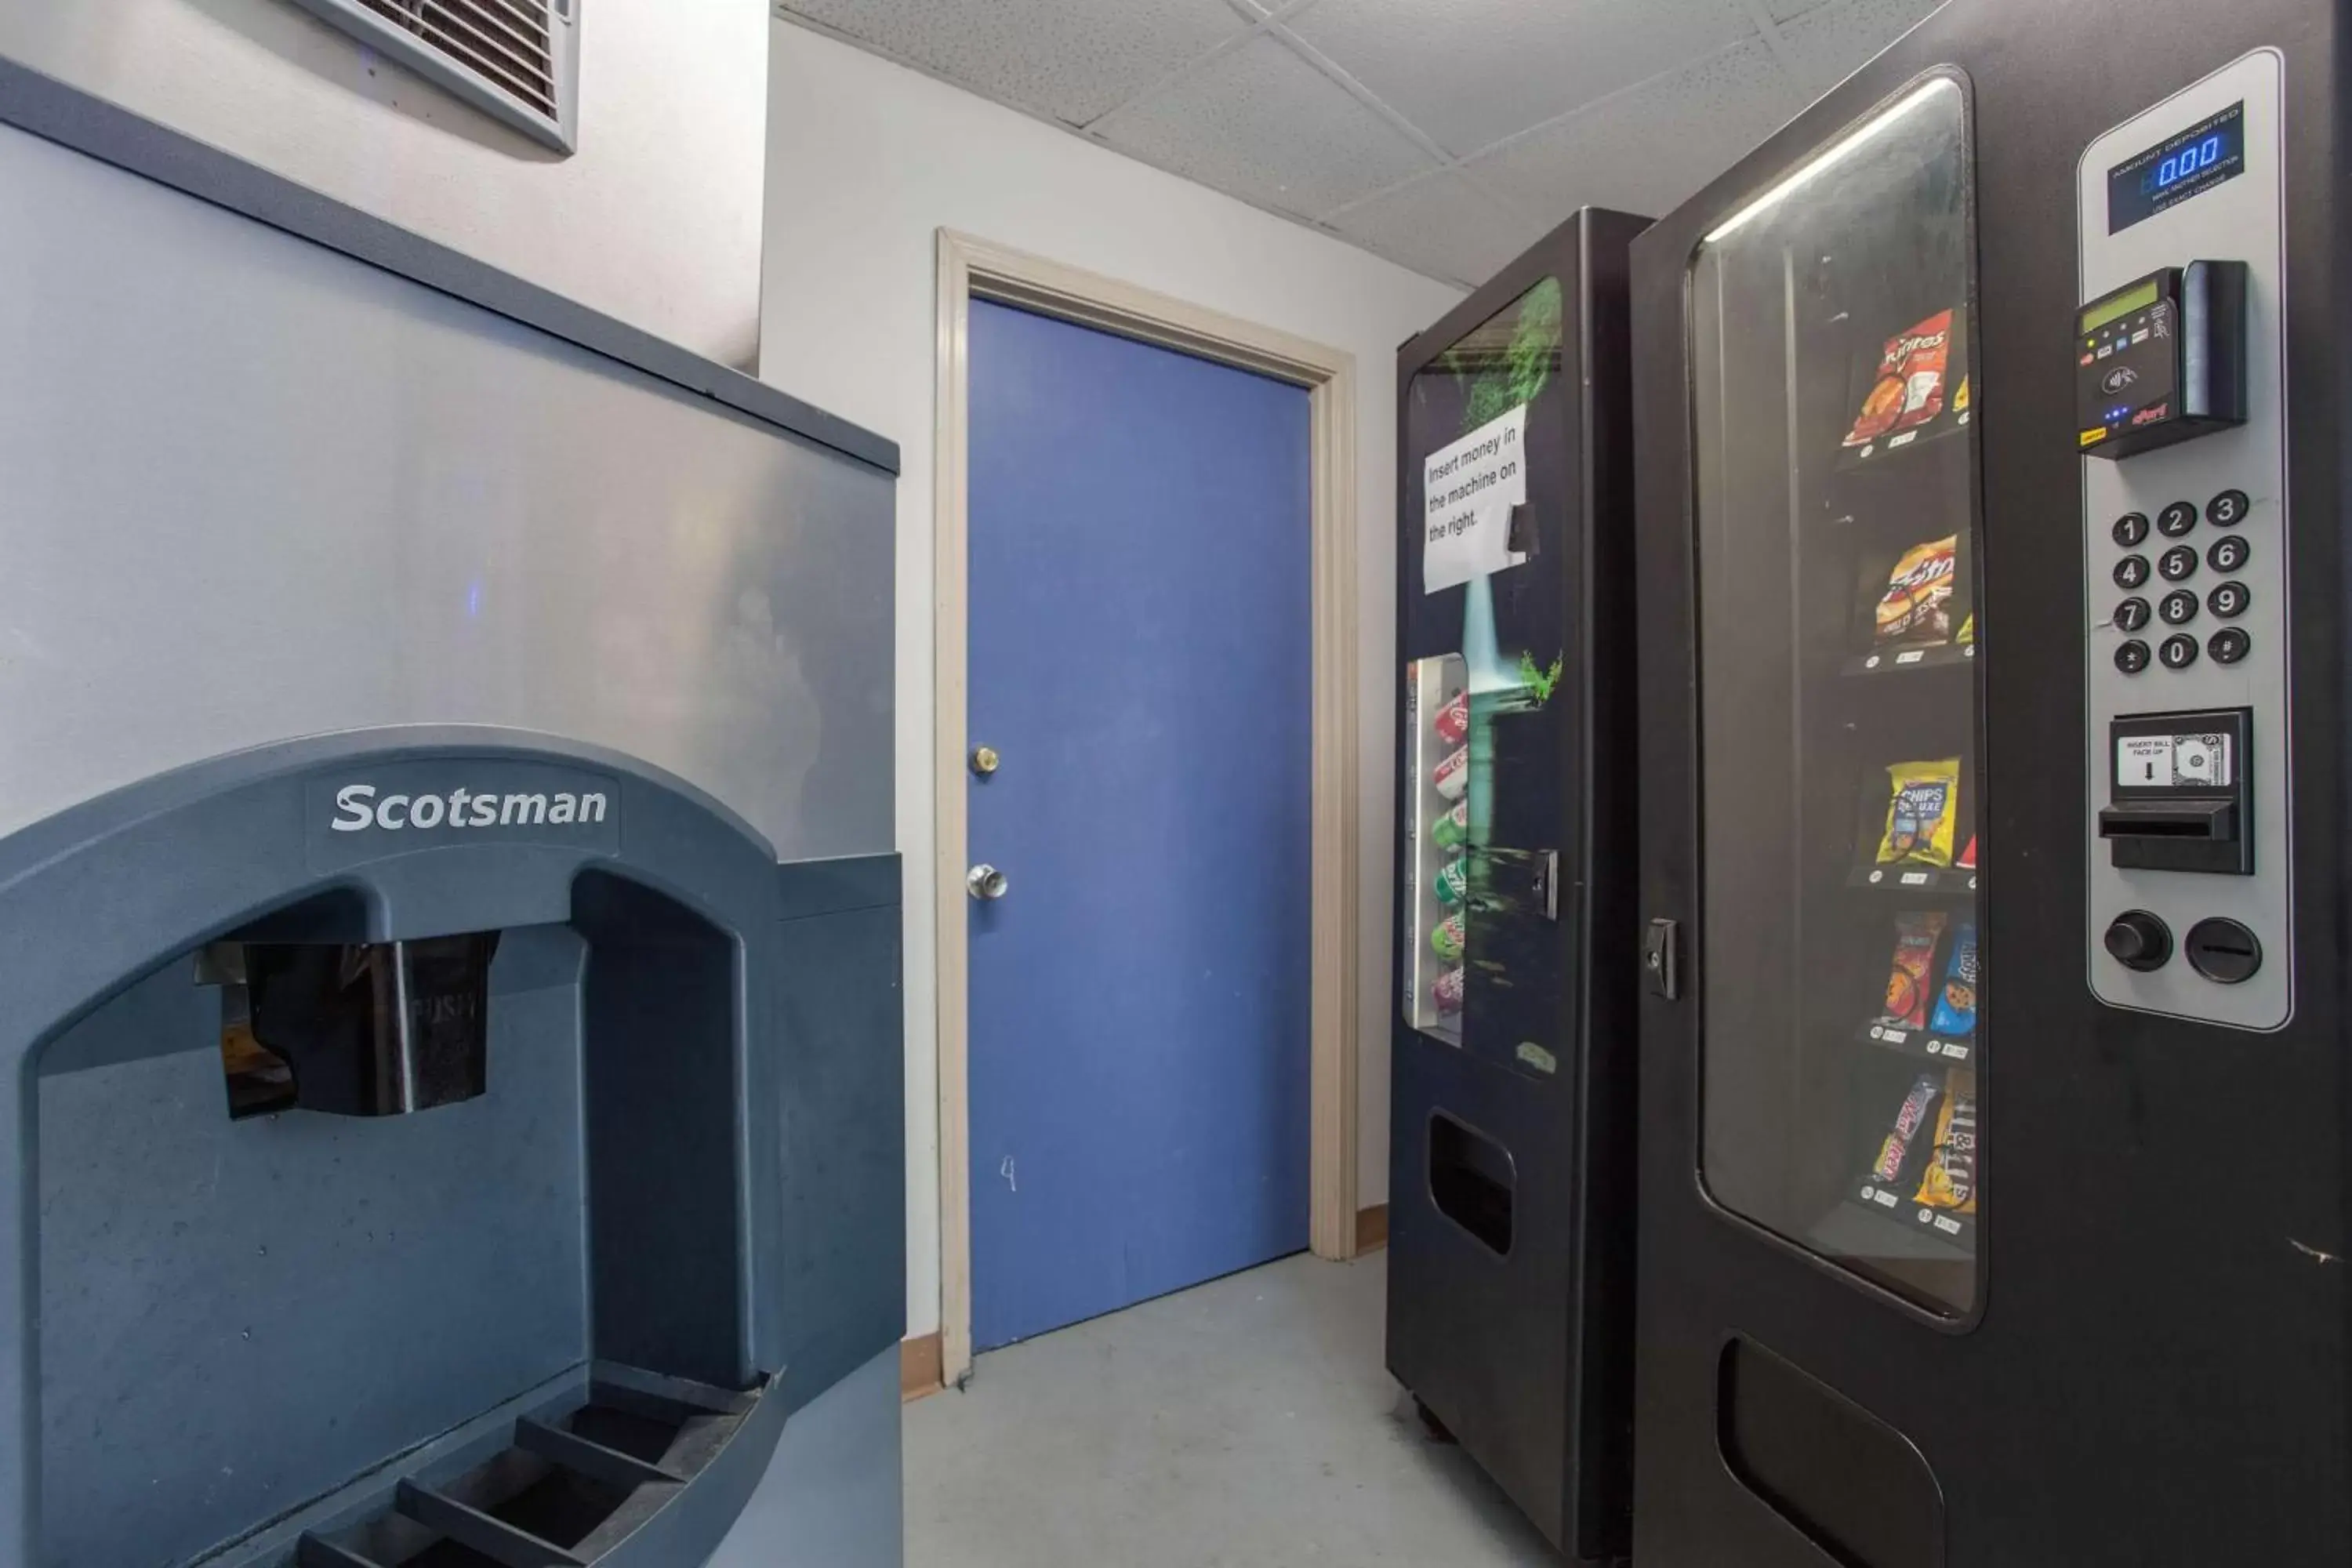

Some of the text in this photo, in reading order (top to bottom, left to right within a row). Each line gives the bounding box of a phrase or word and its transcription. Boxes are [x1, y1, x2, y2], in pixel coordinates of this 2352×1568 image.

[2113, 109, 2238, 179] AMOUNT DEPOSITED
[1428, 426, 1515, 483] Insert money in
[1429, 461, 1516, 513] the machine on
[1429, 510, 1477, 542] the right.
[2124, 498, 2234, 539] 1 2 3
[2122, 543, 2234, 583] 4 5 6
[2125, 589, 2234, 625] 7 8 9
[2170, 642, 2183, 662] 0
[332, 784, 606, 831] Scotsman
[1900, 788, 1943, 802] CHIPS
